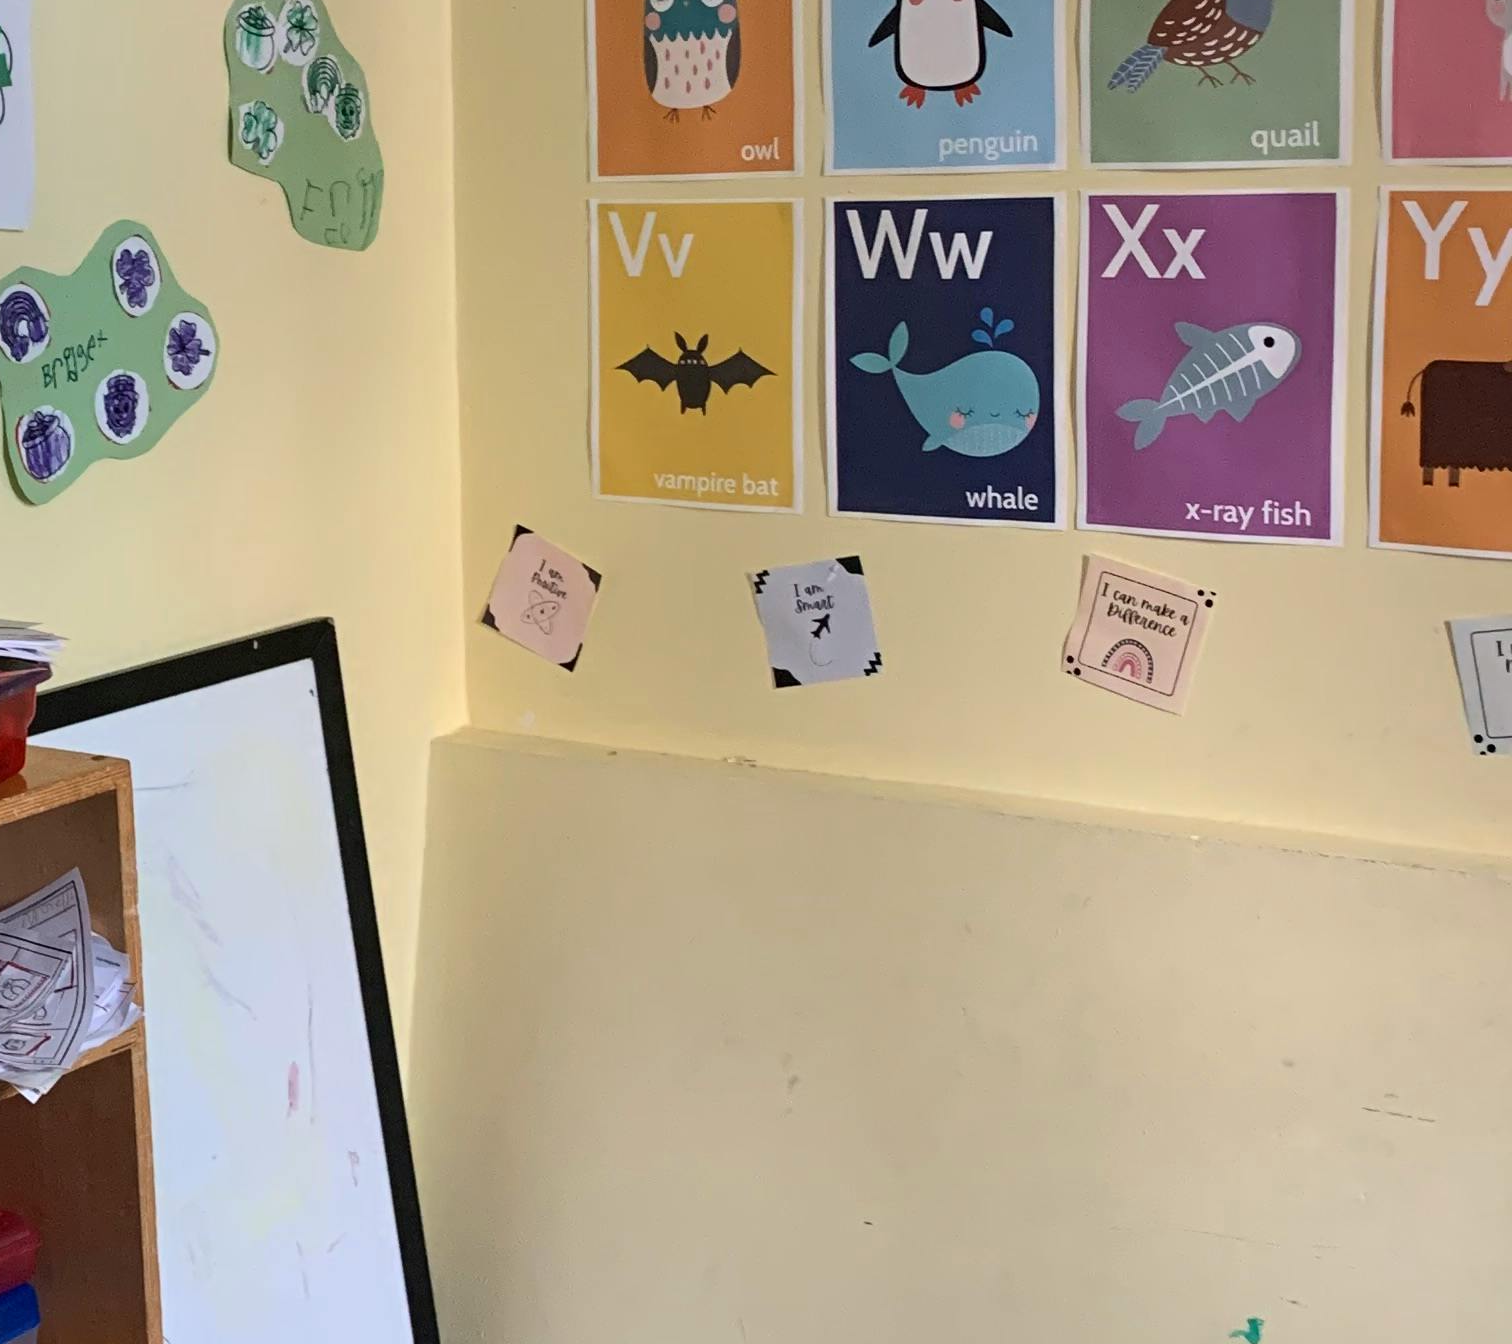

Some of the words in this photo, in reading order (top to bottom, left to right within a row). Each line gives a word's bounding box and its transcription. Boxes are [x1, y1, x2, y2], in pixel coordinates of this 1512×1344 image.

[740, 136, 781, 163] owl
[938, 129, 1039, 162] penguin
[1249, 119, 1321, 156] quail
[607, 209, 695, 279] Vv
[845, 208, 994, 281] Ww
[1100, 202, 1208, 281] Xx
[1401, 199, 1512, 308] Yy
[653, 470, 737, 499] vampire
[741, 472, 779, 497] bat
[966, 485, 1040, 512] whale
[1185, 501, 1255, 531] x-ray
[1261, 499, 1313, 528] fish
[793, 583, 802, 599] I
[803, 584, 825, 598] am
[1100, 581, 1111, 598] I
[1113, 587, 1139, 608] can
[1141, 597, 1179, 621] make
[1178, 611, 1191, 627] a
[1106, 602, 1178, 639] Difference
